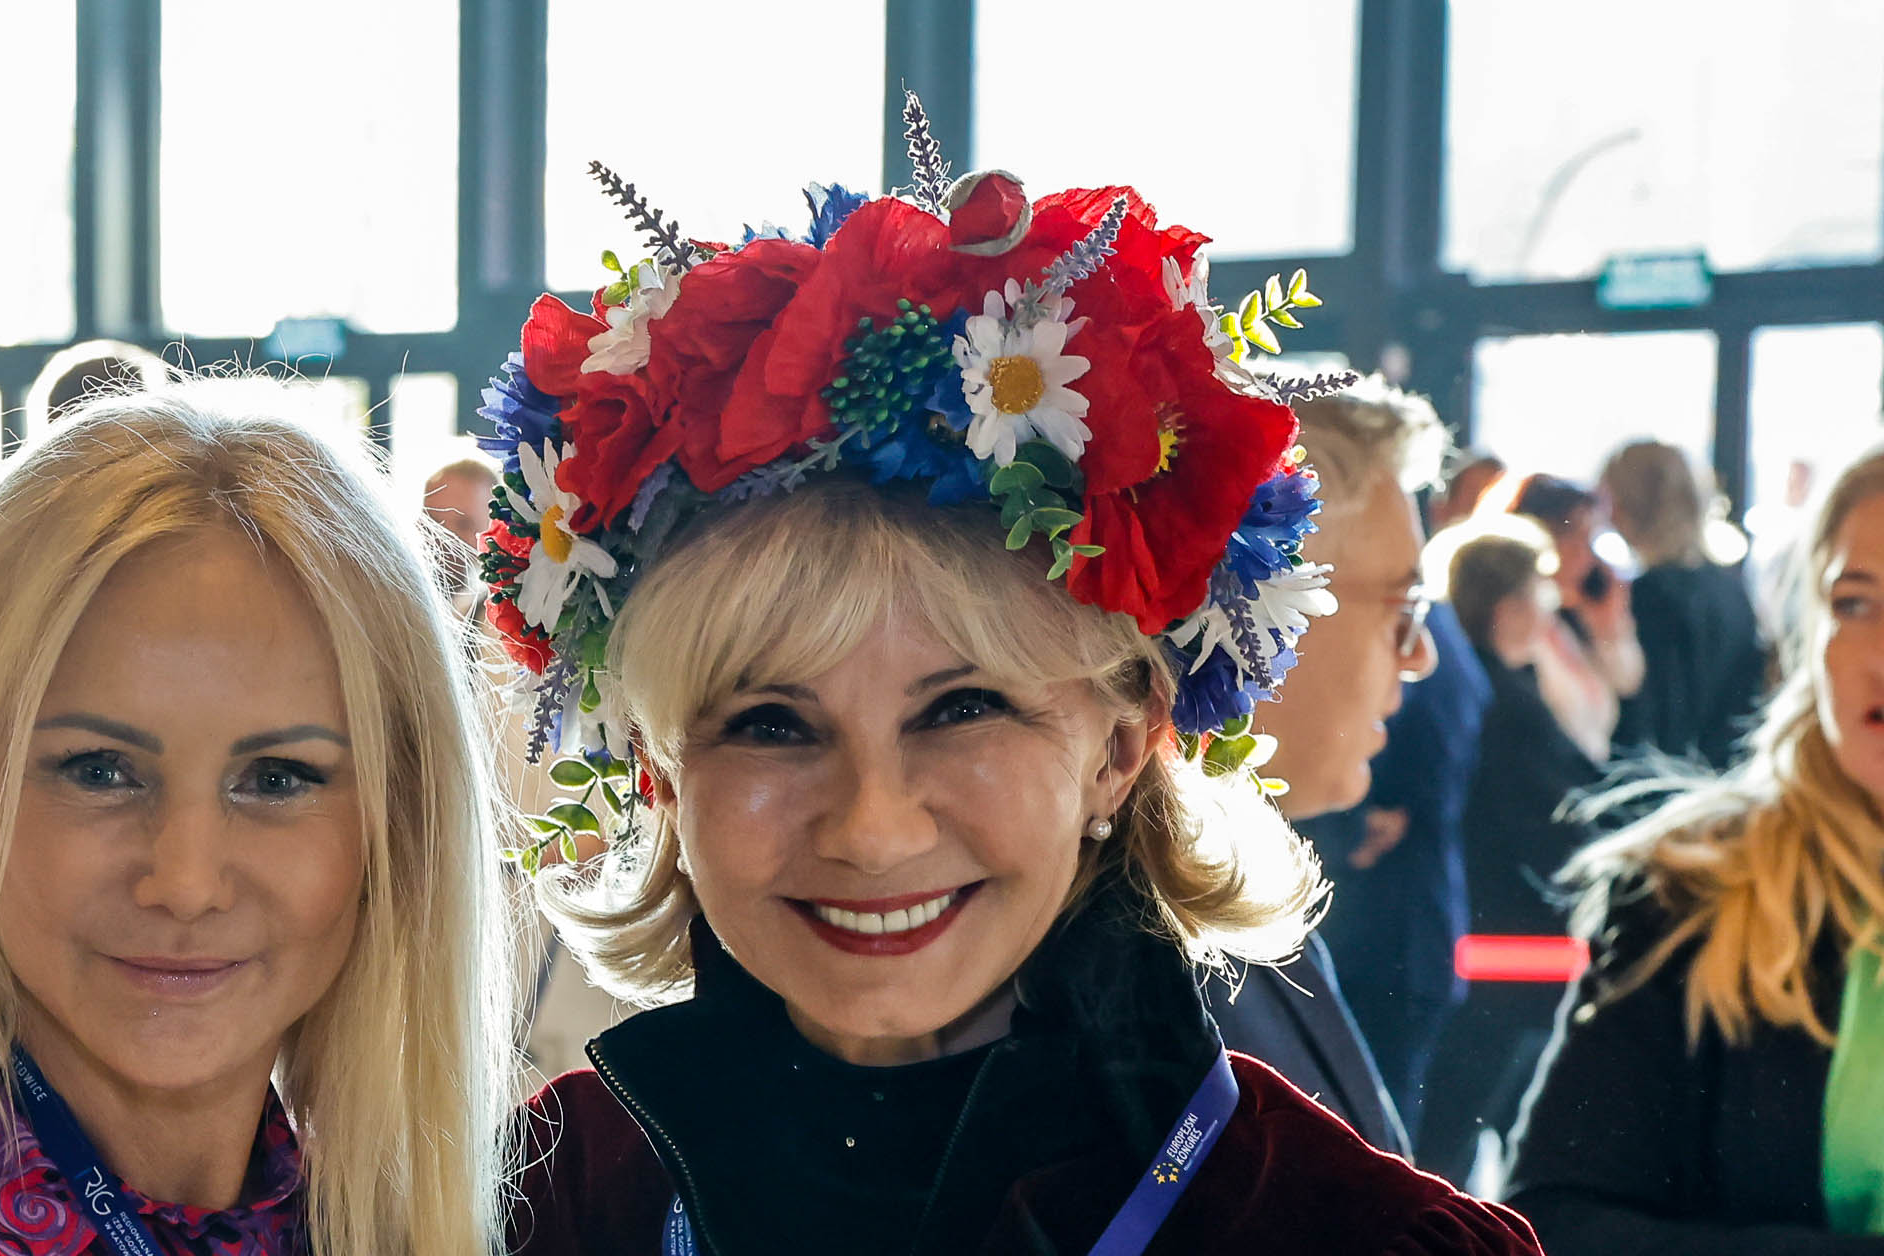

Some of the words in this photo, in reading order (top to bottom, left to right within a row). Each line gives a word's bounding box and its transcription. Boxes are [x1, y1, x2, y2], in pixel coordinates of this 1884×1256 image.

[1166, 1112, 1199, 1158] EUROPEJSKI
[1174, 1128, 1203, 1166] KONGRES
[75, 1166, 114, 1215] RIG
